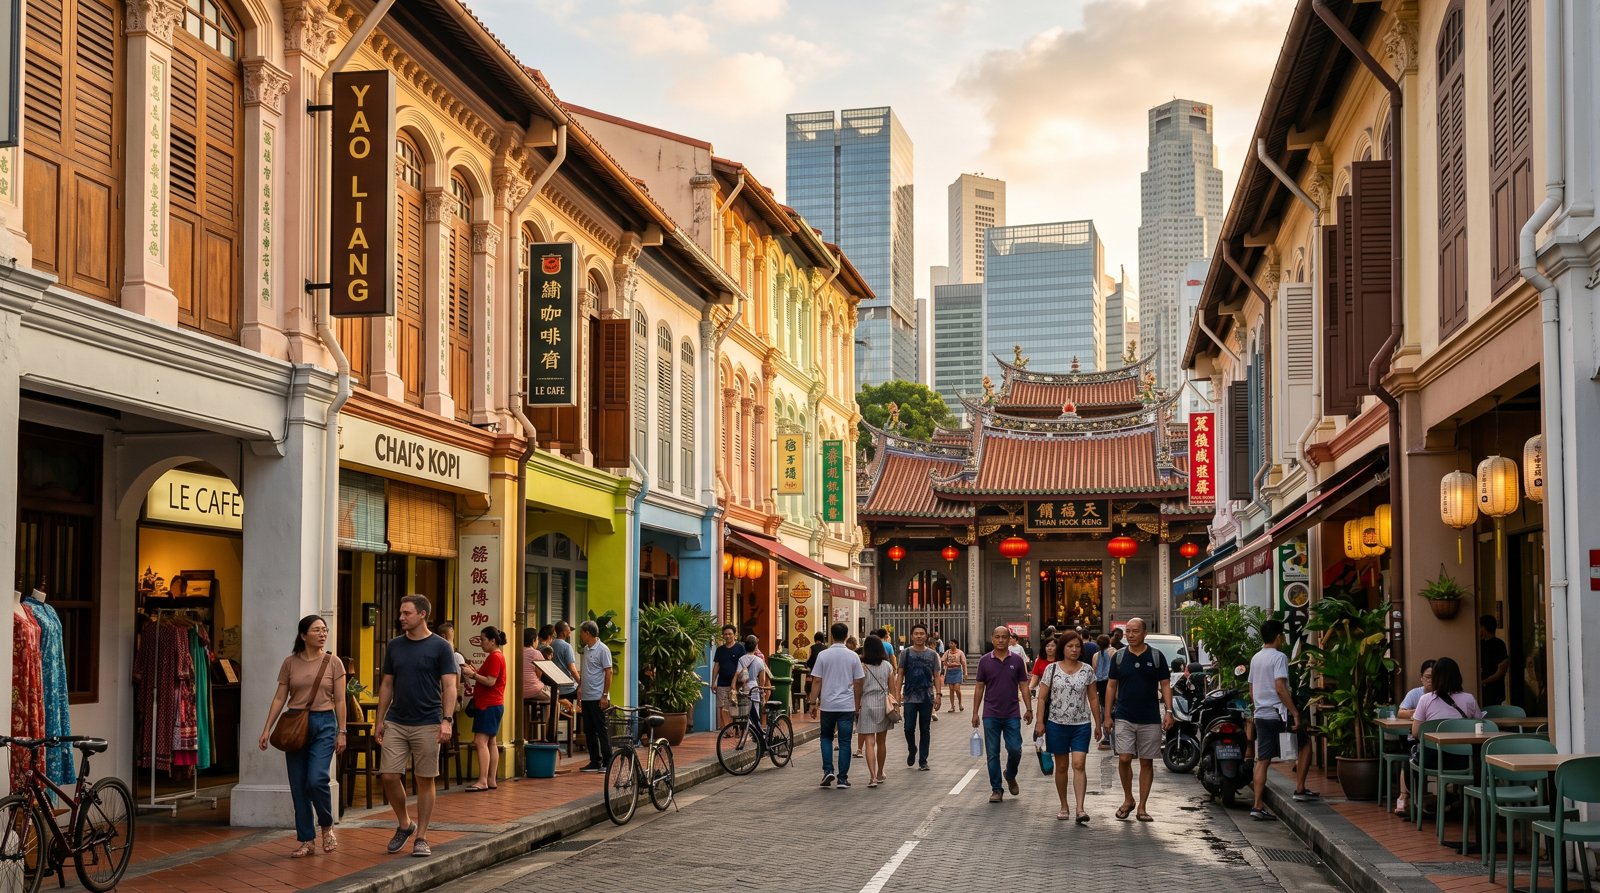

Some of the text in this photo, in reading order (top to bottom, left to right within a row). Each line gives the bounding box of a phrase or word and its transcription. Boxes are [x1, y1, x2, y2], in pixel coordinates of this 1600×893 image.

[349, 84, 370, 159] YAO
[347, 175, 369, 302] LIANG
[535, 386, 566, 396] LE CAFE
[375, 433, 460, 480] CHAI'S KOPI
[169, 482, 240, 517] LE CAFE
